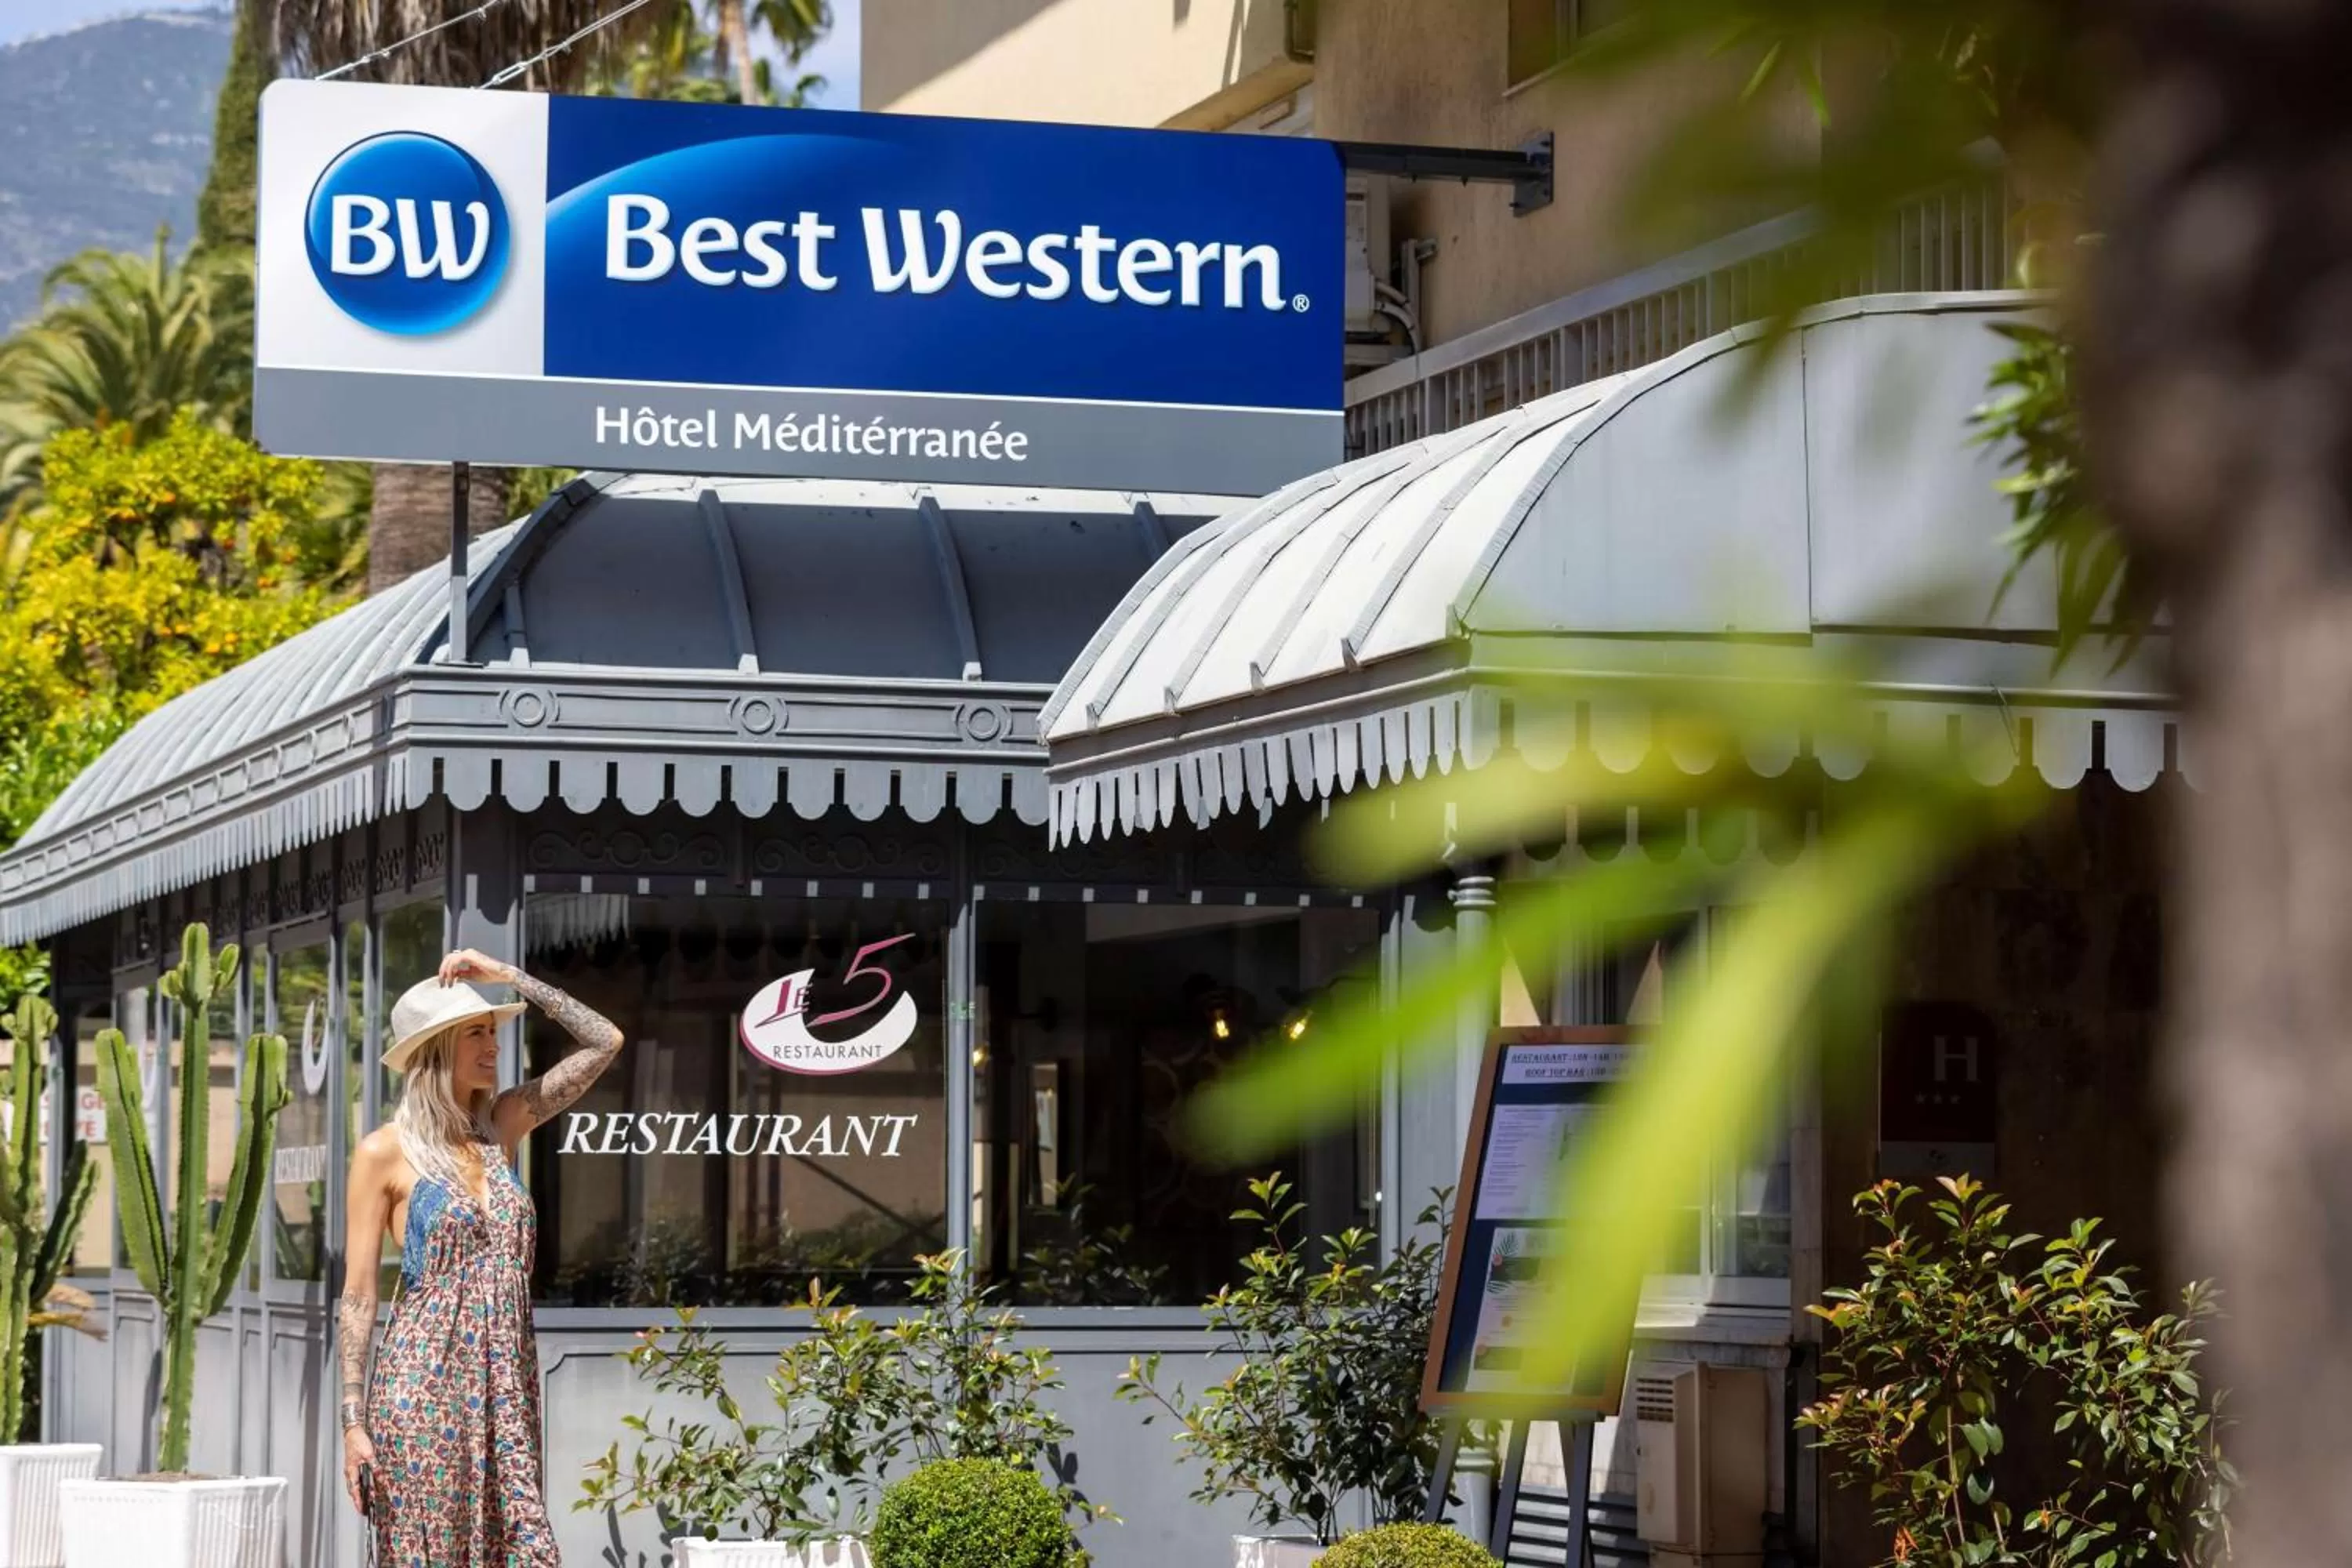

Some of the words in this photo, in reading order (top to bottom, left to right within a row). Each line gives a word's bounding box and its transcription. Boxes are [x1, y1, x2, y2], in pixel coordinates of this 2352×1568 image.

[330, 194, 490, 281] BW
[606, 193, 837, 292] Best
[595, 405, 718, 449] Hôtel
[733, 412, 1029, 462] Méditérranée
[805, 932, 916, 1028] 5
[772, 1045, 884, 1060] RESTAURANT
[1932, 1035, 1981, 1083] H
[557, 1111, 919, 1158] RESTAURANT
